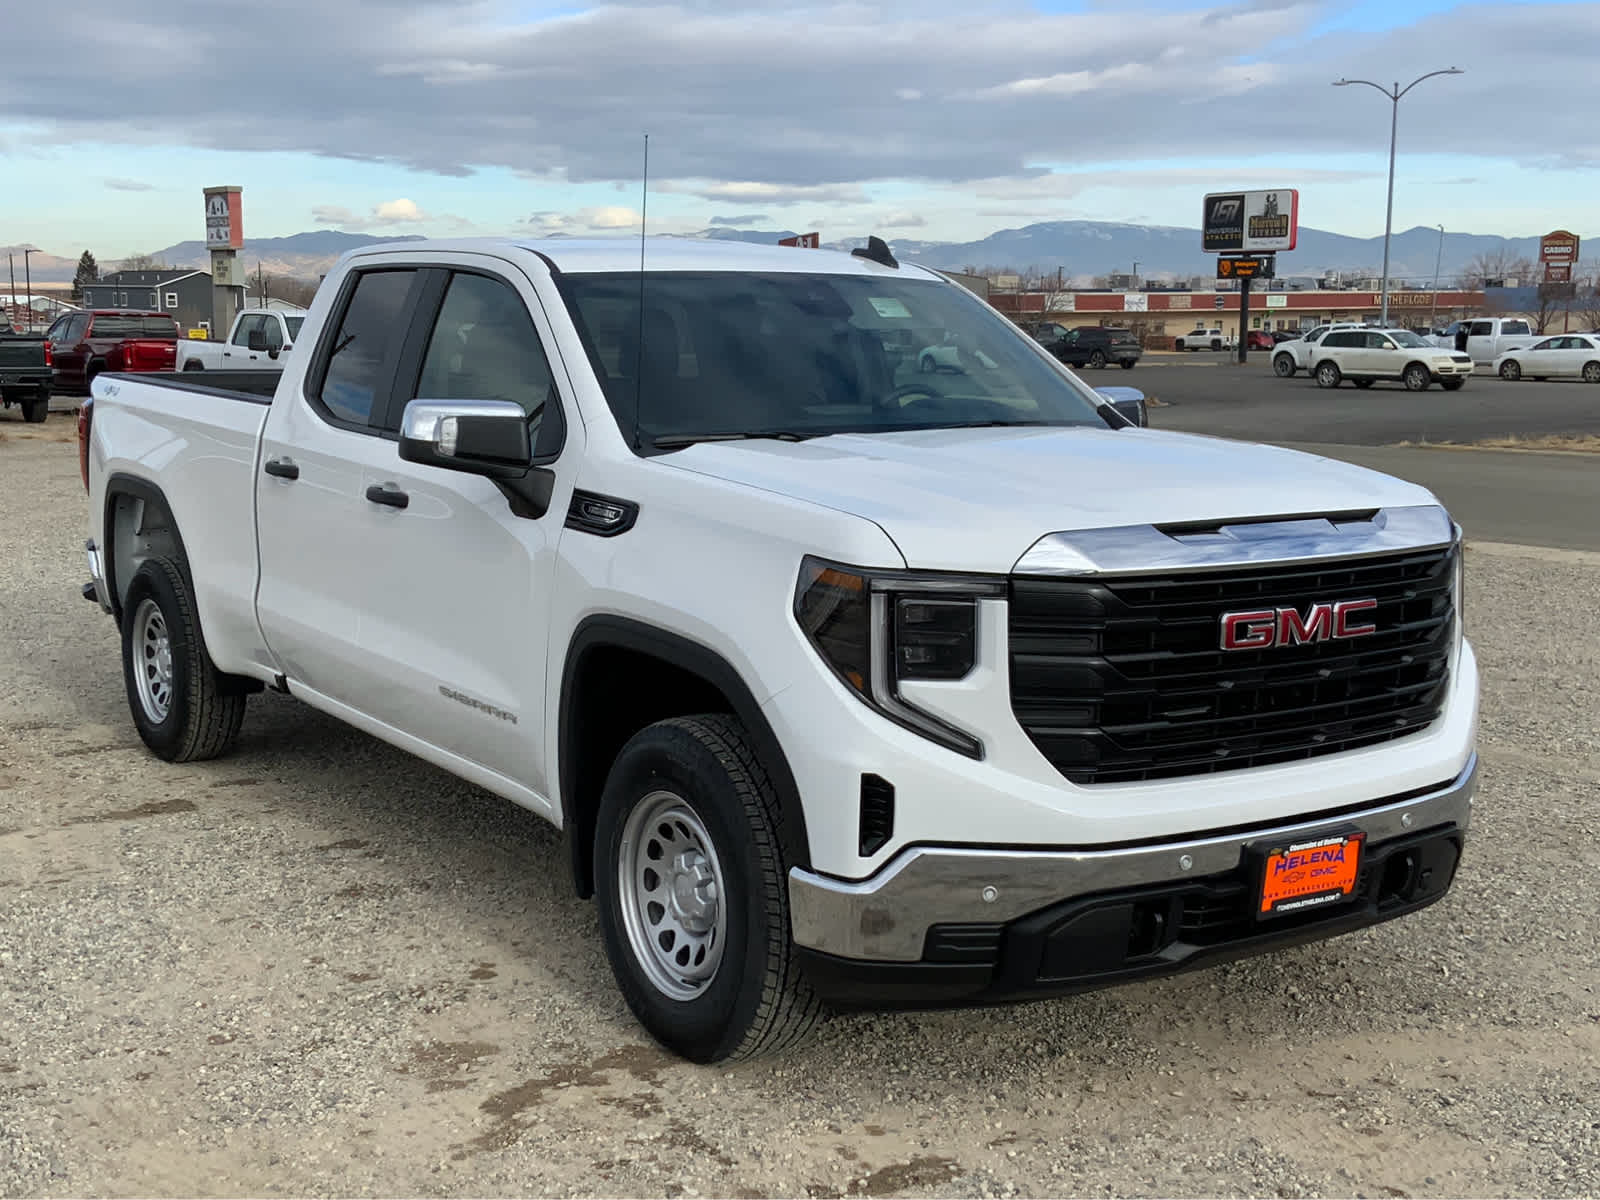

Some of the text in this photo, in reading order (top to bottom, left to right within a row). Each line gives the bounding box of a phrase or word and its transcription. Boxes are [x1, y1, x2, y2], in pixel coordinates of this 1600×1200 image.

[1543, 246, 1572, 254] CASINO
[1373, 295, 1432, 305] MTHERLODE
[1220, 598, 1378, 650] GMC
[1273, 848, 1345, 877] HELENA
[1310, 866, 1337, 877] GMC
